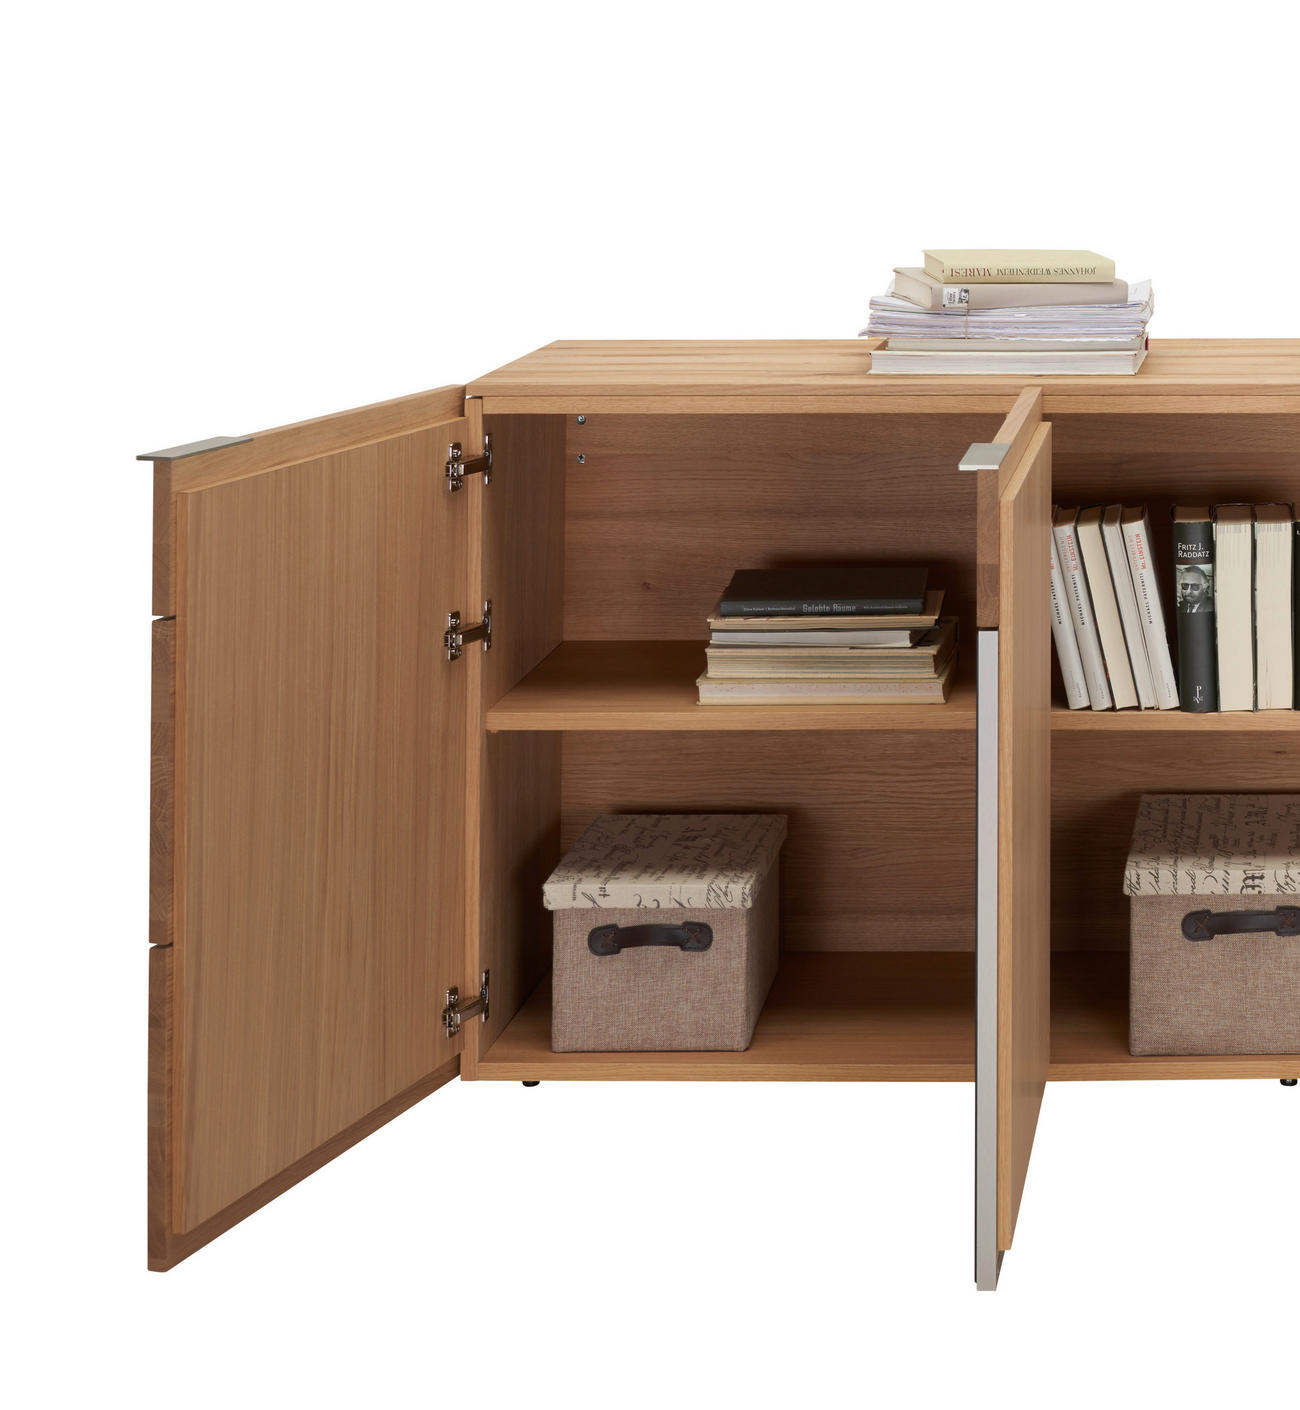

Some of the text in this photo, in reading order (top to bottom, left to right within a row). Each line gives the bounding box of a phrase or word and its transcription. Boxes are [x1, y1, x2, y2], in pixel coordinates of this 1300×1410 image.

[950, 267, 1096, 277] JOHANNES WEIDENHEIM MARESI
[1198, 542, 1204, 551] J.
[1178, 550, 1209, 558] RADDATZ
